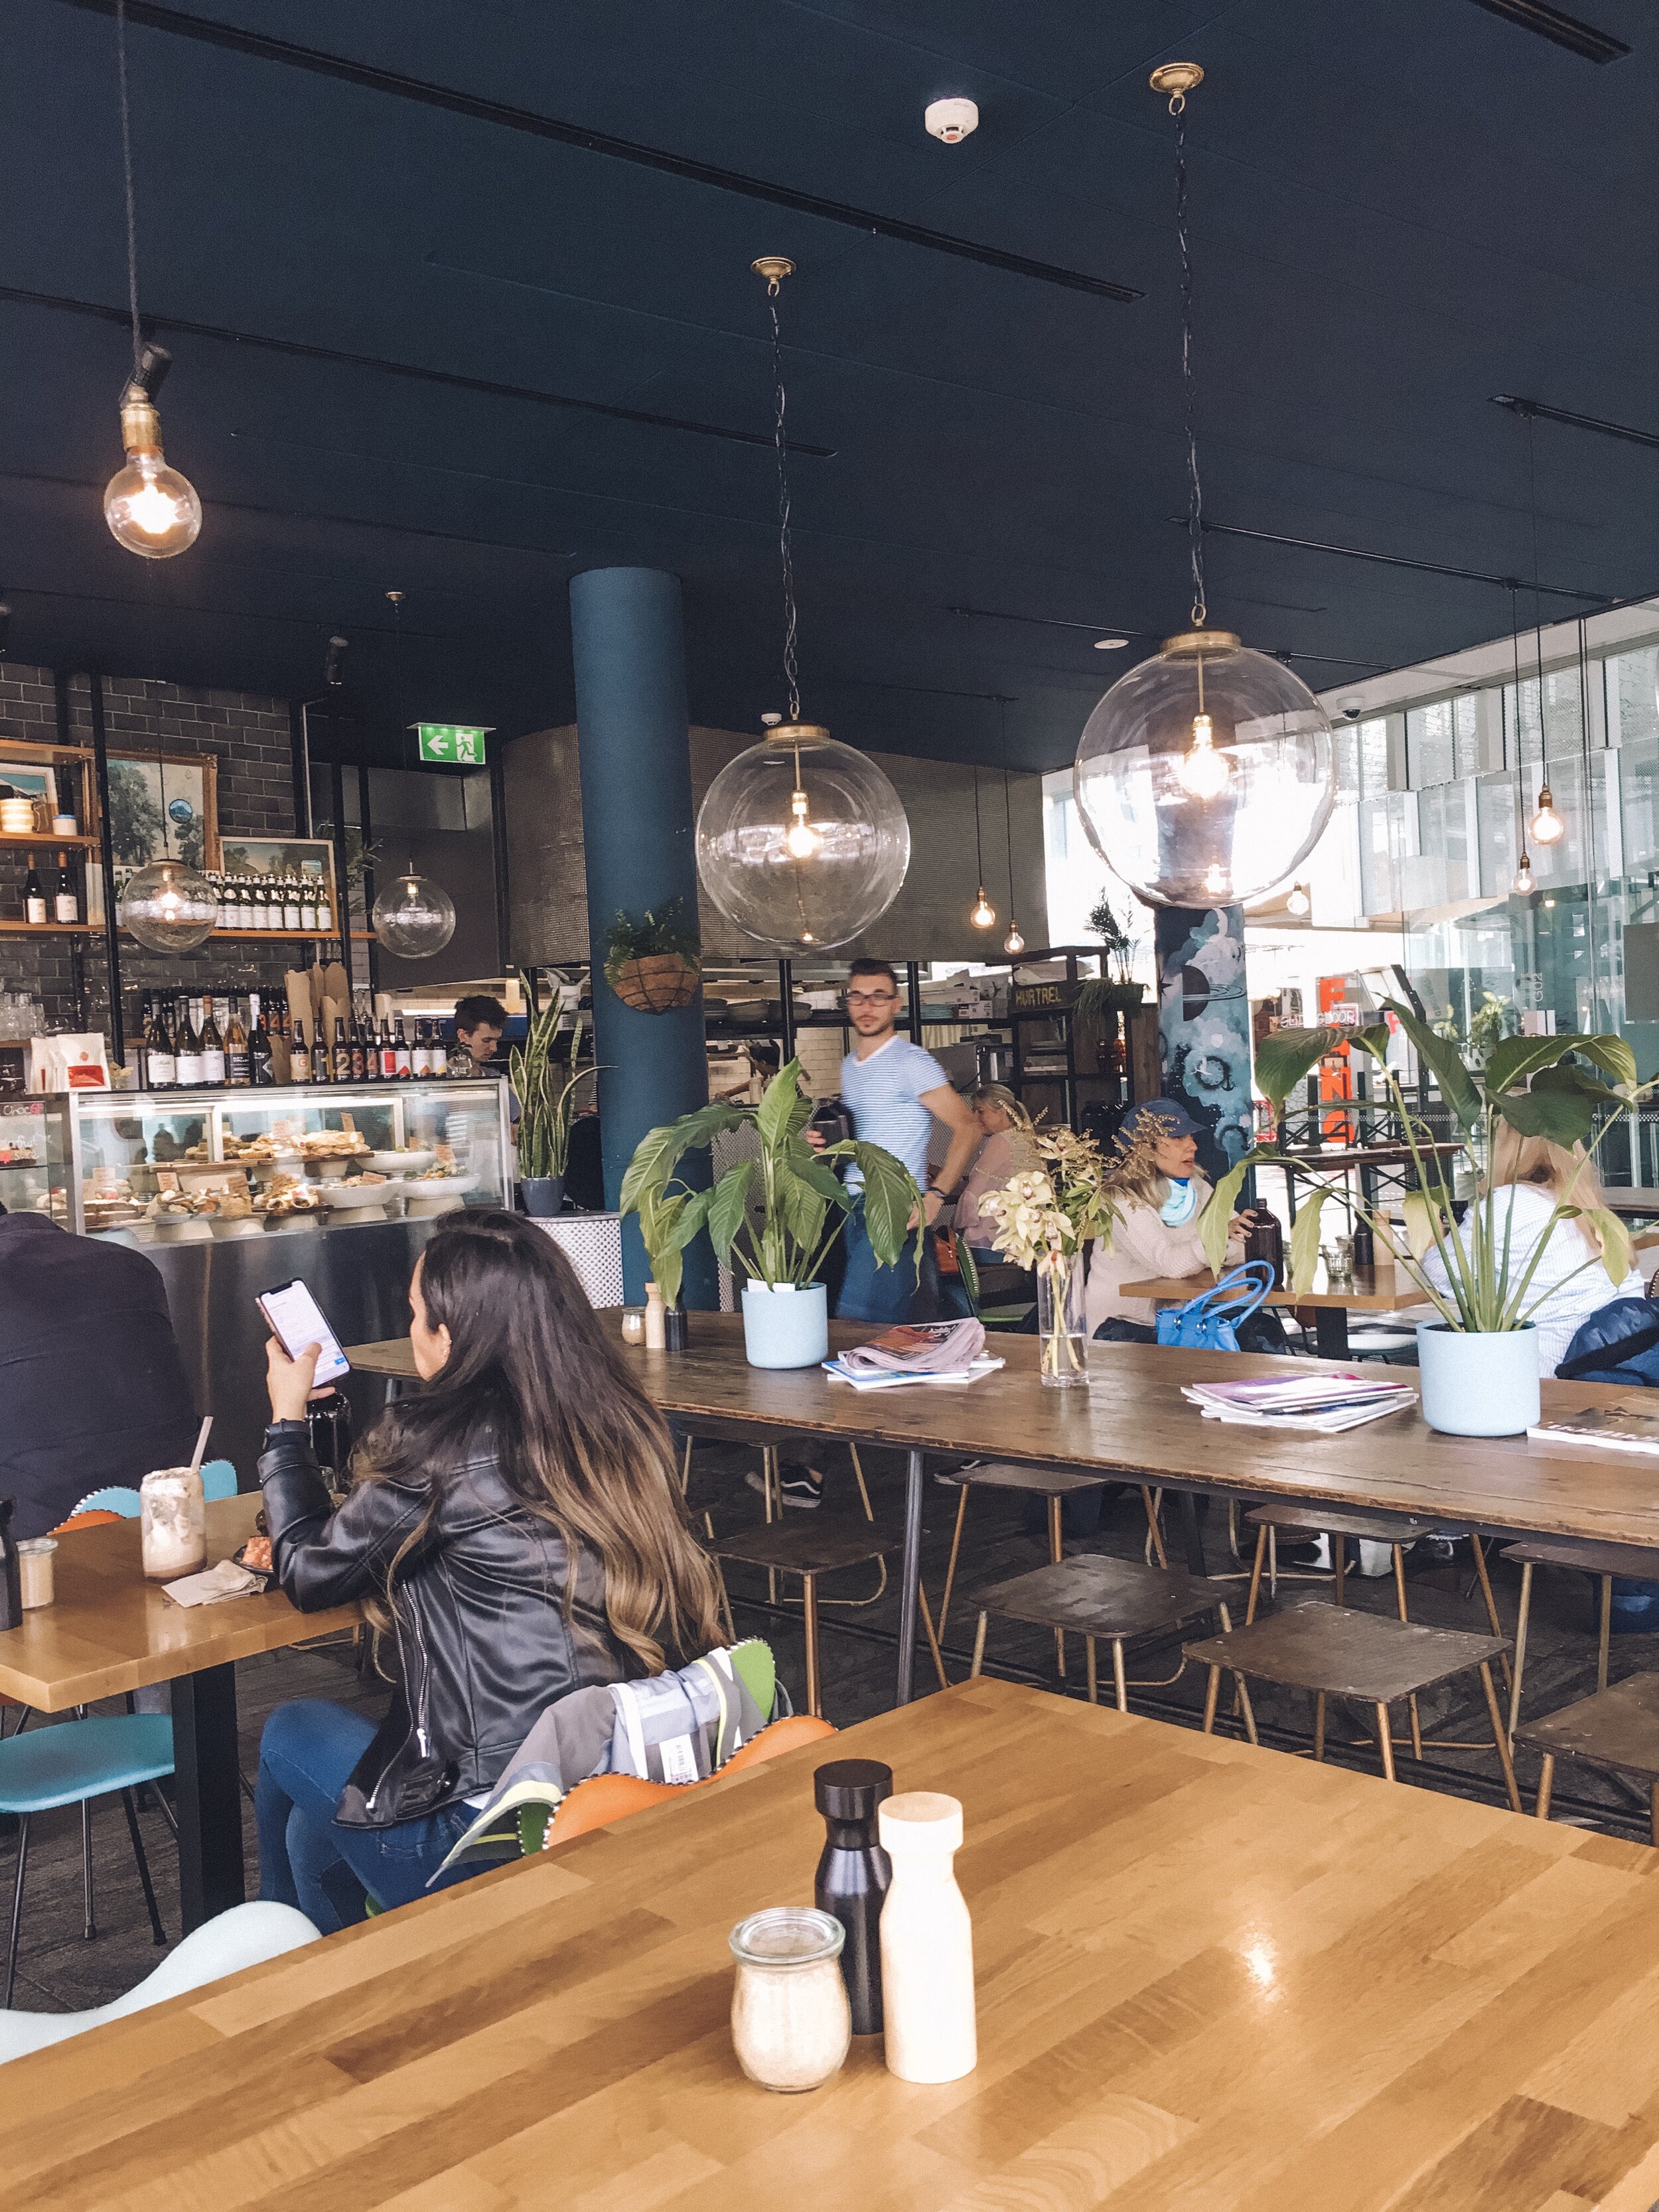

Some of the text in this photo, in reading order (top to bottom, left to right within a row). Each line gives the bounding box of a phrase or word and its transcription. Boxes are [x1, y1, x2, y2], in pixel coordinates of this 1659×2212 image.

[336, 1053, 350, 1075] 2
[352, 1053, 364, 1074] 3
[366, 1052, 378, 1074] 4
